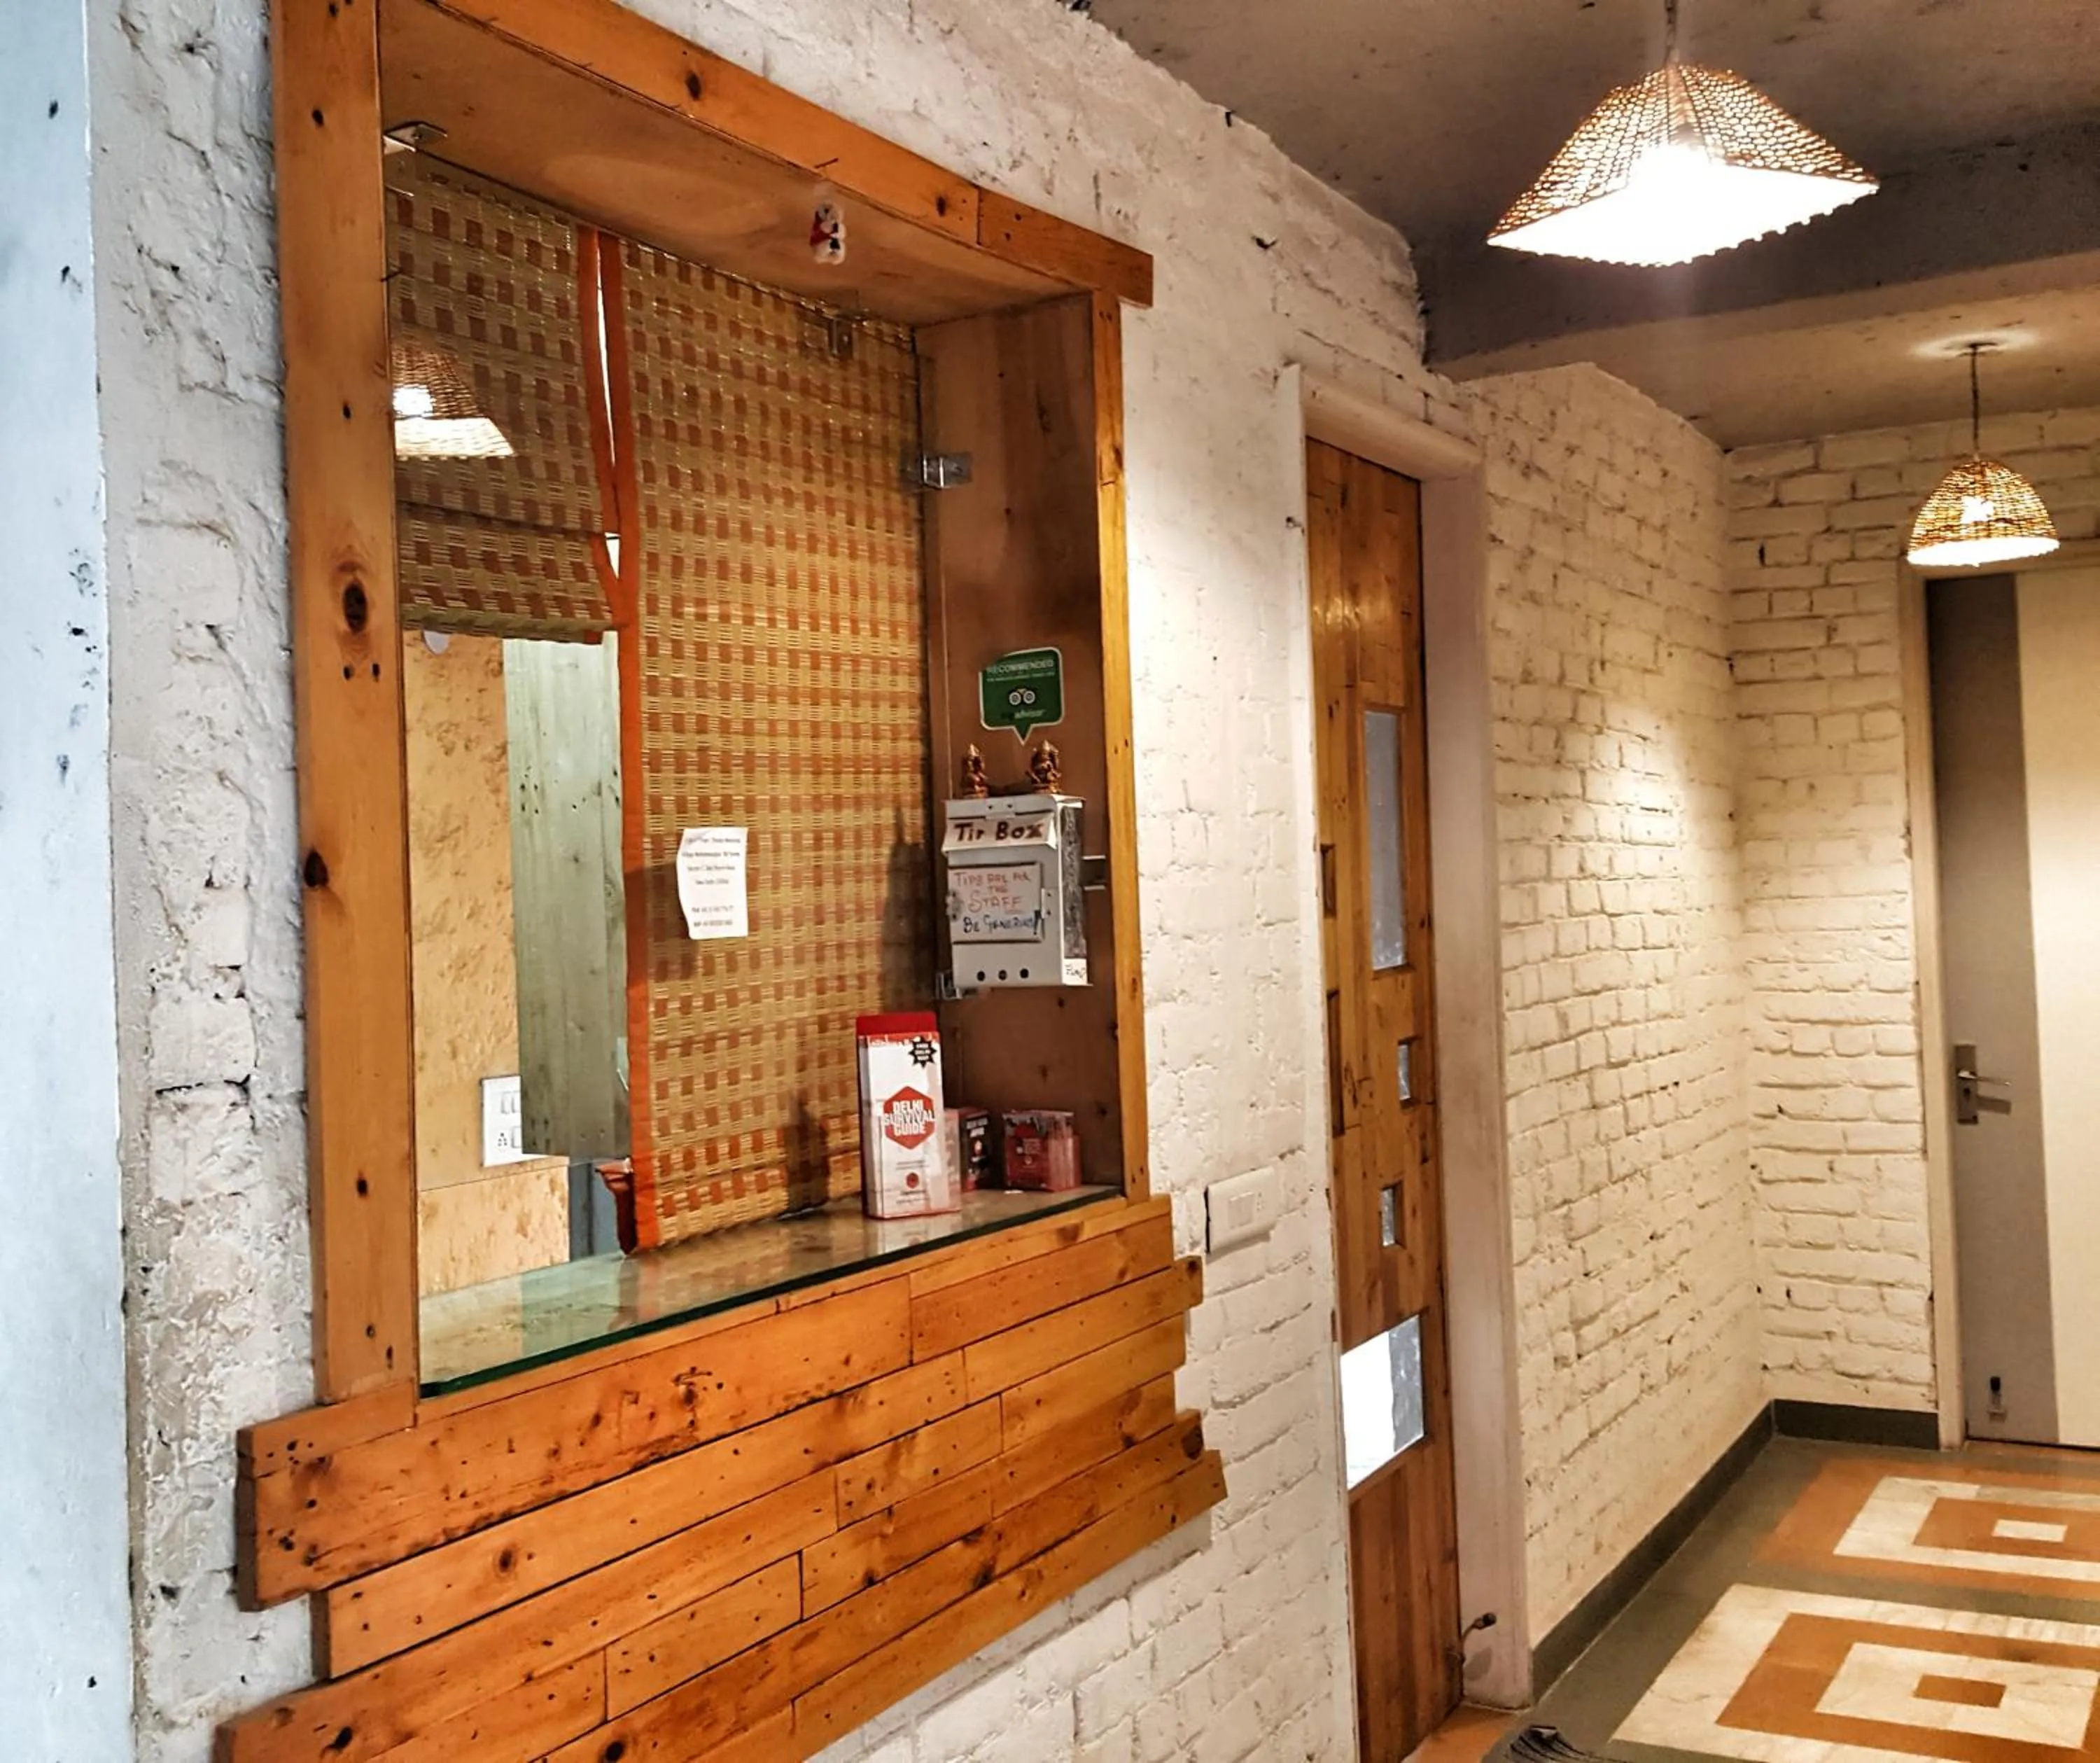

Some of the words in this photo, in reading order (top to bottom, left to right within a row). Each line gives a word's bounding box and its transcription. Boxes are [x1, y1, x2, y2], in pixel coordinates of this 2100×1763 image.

[892, 1099, 923, 1114] DELHI
[883, 1109, 936, 1126] SURVIVAL
[894, 1122, 927, 1136] GUIDE
